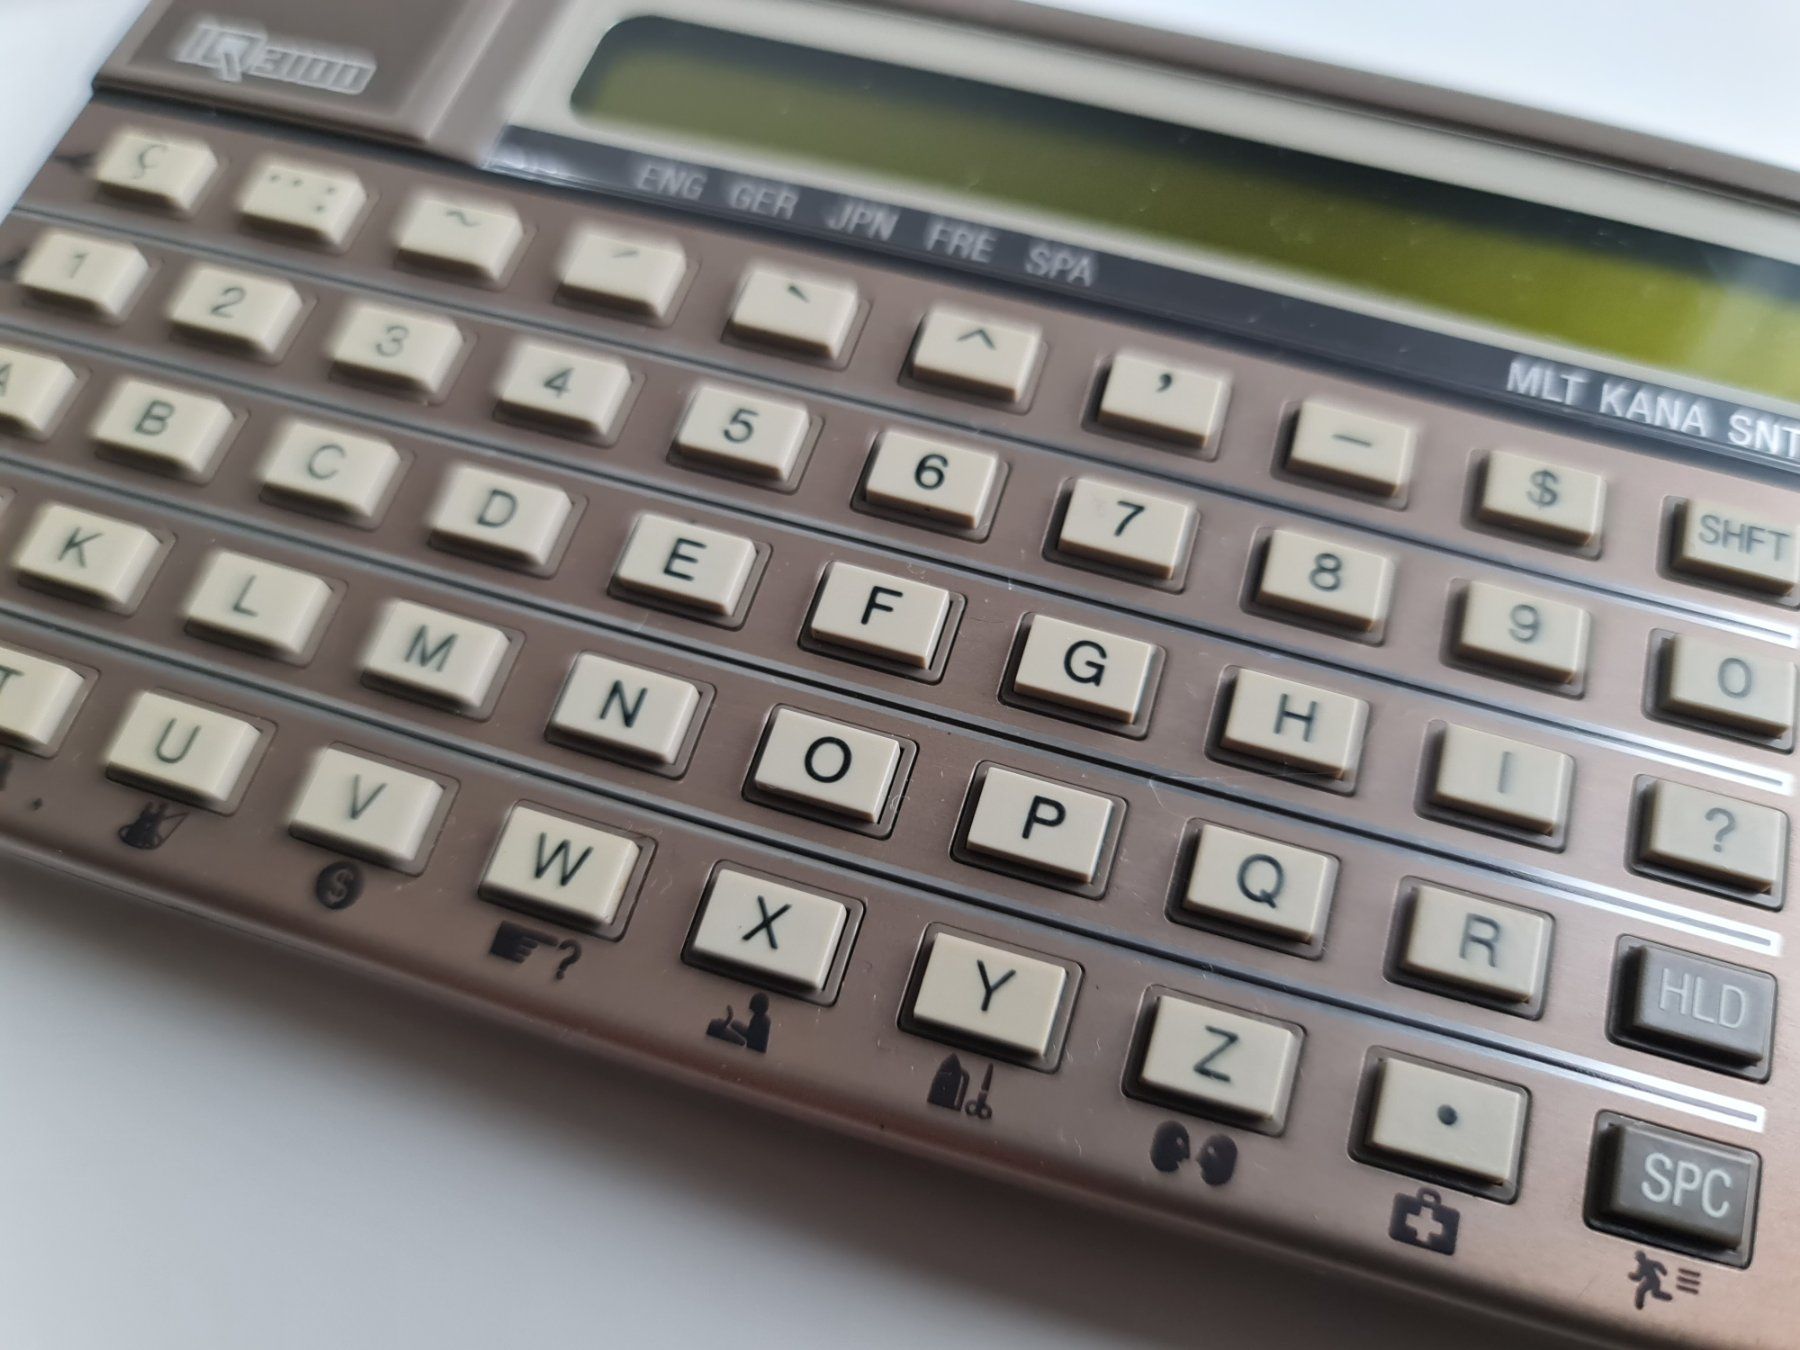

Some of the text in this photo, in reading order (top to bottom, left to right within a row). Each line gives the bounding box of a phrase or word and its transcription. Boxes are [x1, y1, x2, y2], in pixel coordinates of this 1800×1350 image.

[635, 164, 1094, 288] ENG GER JPN FRE SPA
[68, 252, 91, 280] 1
[209, 286, 247, 319] 2
[373, 324, 411, 360] 3
[542, 366, 575, 400] 4
[1506, 359, 1586, 406] MLT
[1600, 380, 1708, 437] KANA
[133, 400, 175, 437] B
[722, 408, 759, 444] 5
[305, 443, 347, 481] C
[913, 453, 950, 491] 6
[475, 488, 518, 529] D
[1526, 469, 1560, 509] $
[1113, 499, 1145, 537] 7
[1697, 513, 1791, 563] SHFT
[57, 525, 104, 569] K
[662, 536, 708, 582] E
[1308, 552, 1343, 592] 8
[231, 574, 259, 618] L
[859, 585, 905, 626] F
[1507, 603, 1543, 644] 9
[403, 624, 459, 673] M
[1062, 639, 1109, 688] G
[599, 680, 648, 729] N
[1273, 692, 1318, 743] H
[154, 718, 202, 764] U
[803, 735, 853, 784] O
[348, 774, 390, 822] V
[1021, 794, 1067, 840] P
[1704, 806, 1737, 854] ?
[533, 831, 594, 887] W
[1236, 853, 1285, 909] Q
[741, 895, 792, 950] X
[1458, 912, 1501, 968] R
[976, 960, 1017, 1013] Y
[1657, 966, 1748, 1031] HLD
[1193, 1025, 1240, 1083] Z
[1640, 1151, 1734, 1219] SPC
